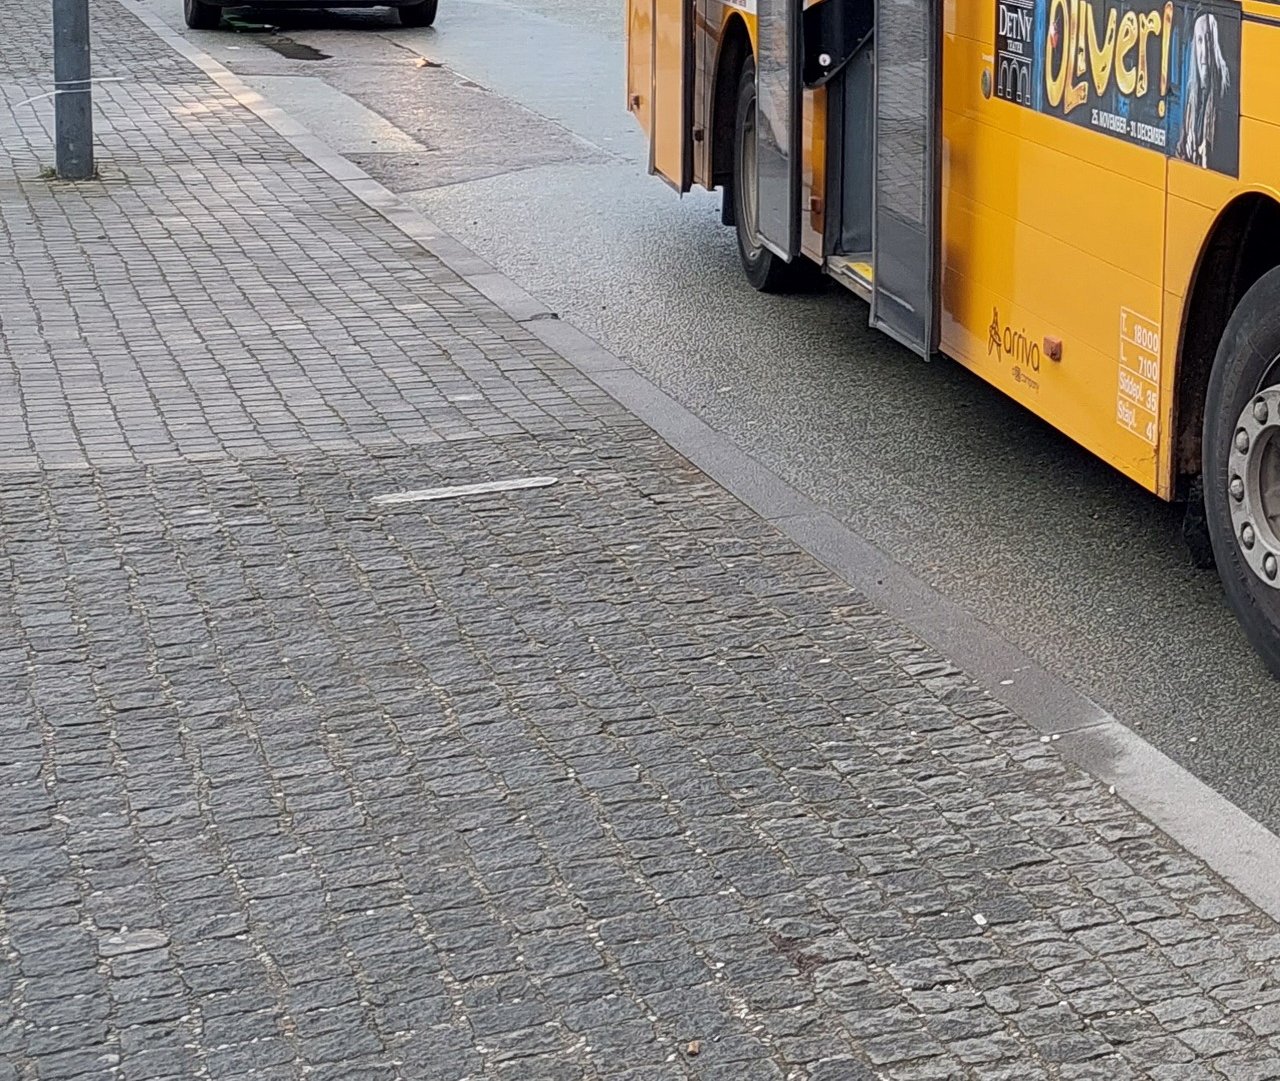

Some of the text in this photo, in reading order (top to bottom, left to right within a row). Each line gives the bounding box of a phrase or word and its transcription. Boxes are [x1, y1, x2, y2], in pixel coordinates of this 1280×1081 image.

[1099, 110, 1127, 134] NOVEMBER
[1137, 122, 1166, 147] DECEMBER
[1003, 325, 1041, 374] arriva
[1133, 324, 1159, 353] 18000
[1138, 355, 1158, 382] 7100
[1145, 389, 1157, 412] 35
